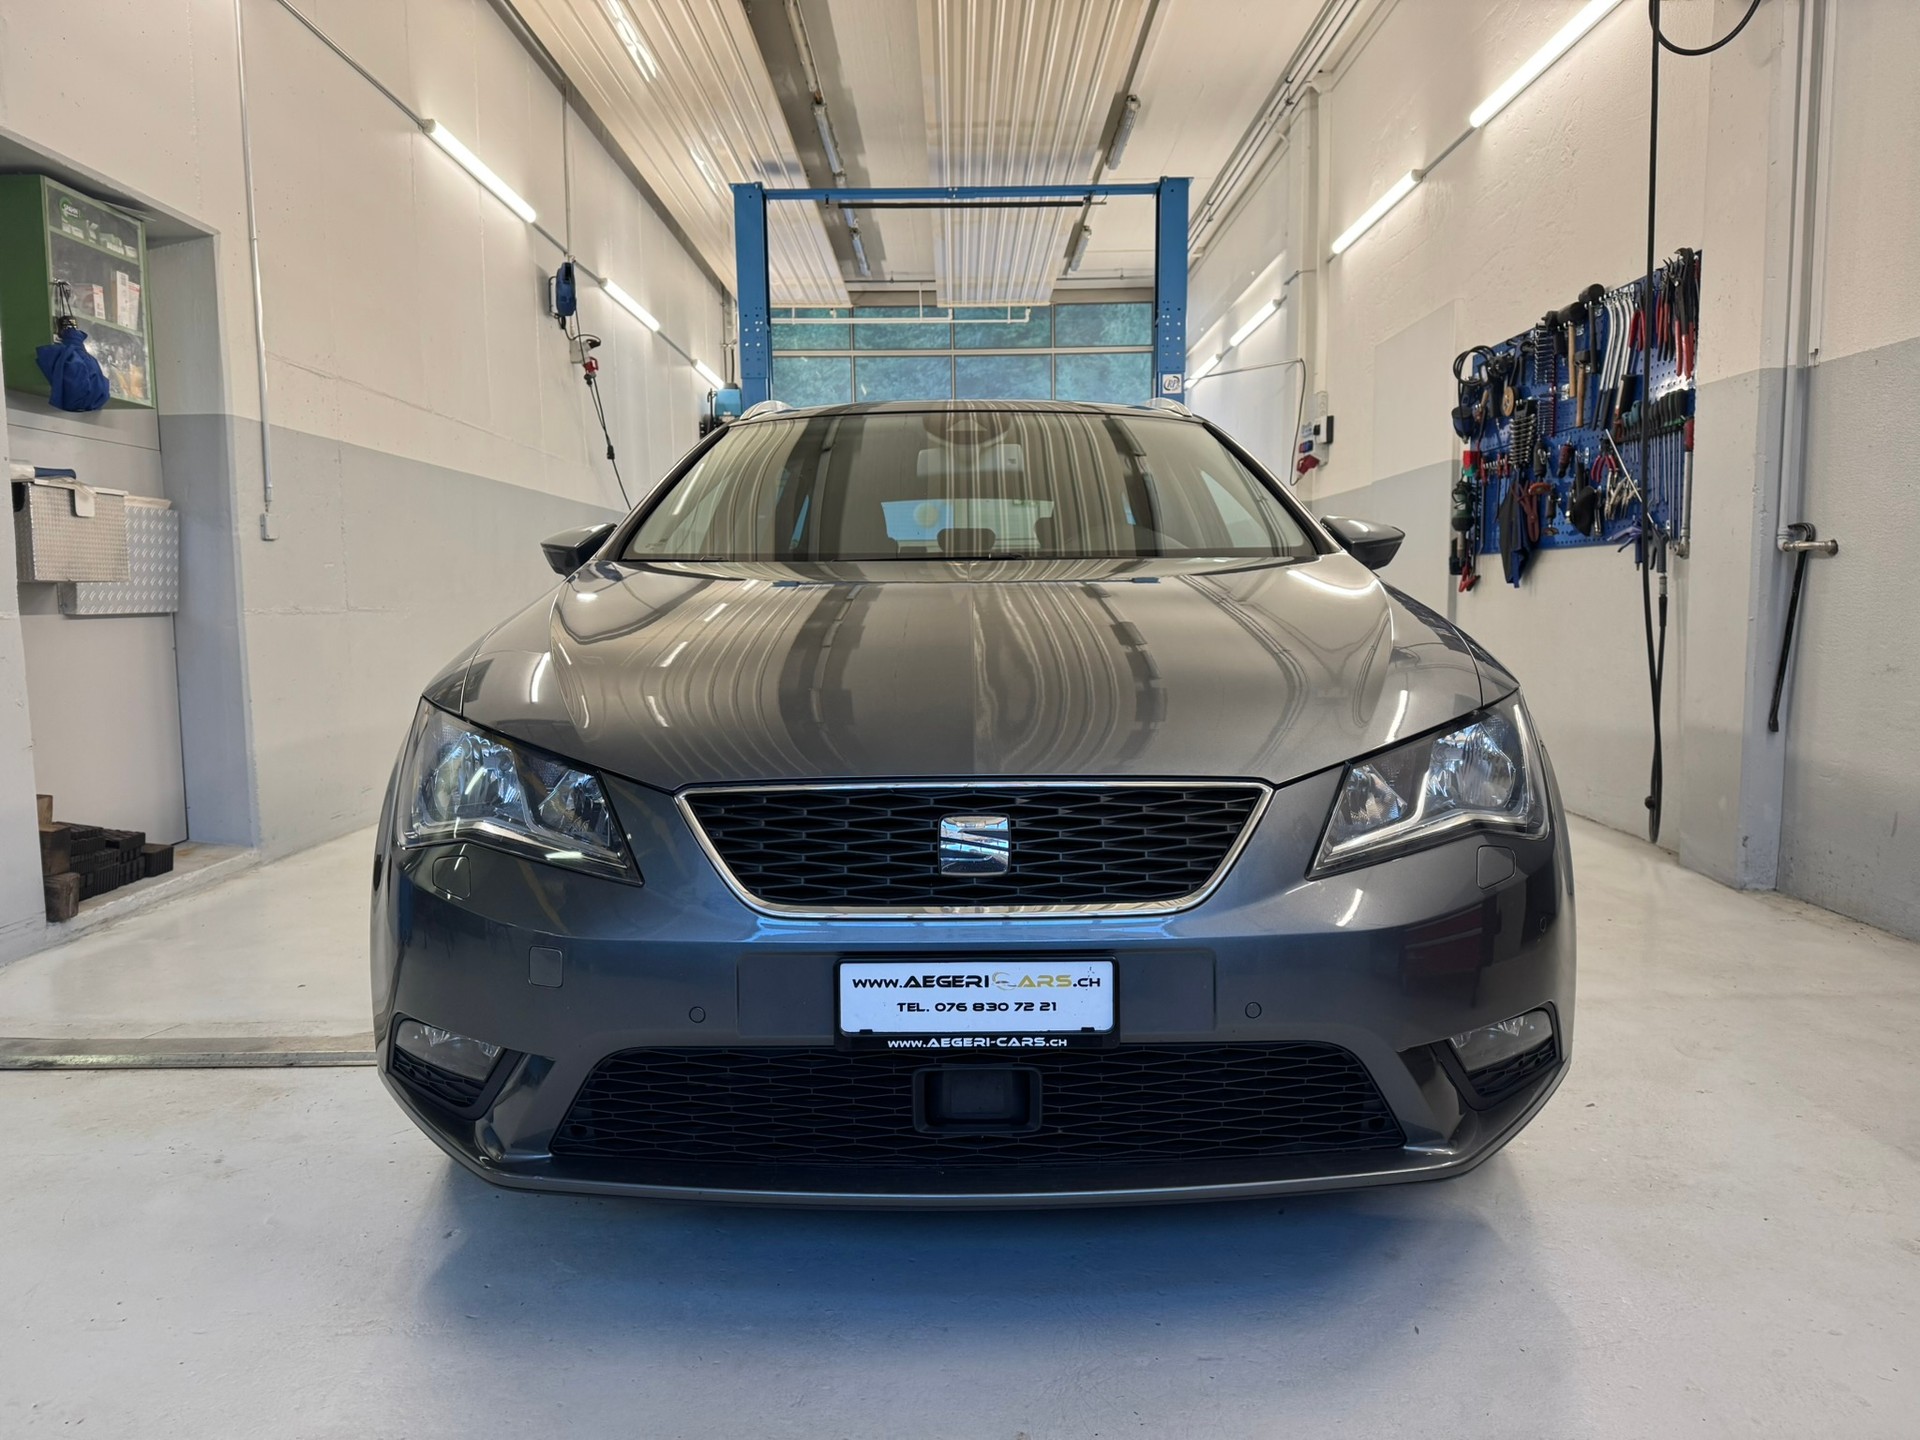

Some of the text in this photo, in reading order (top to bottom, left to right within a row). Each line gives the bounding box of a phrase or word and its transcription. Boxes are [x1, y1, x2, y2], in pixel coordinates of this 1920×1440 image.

[897, 1002, 1057, 1013] TEL. 076 830 72 21
